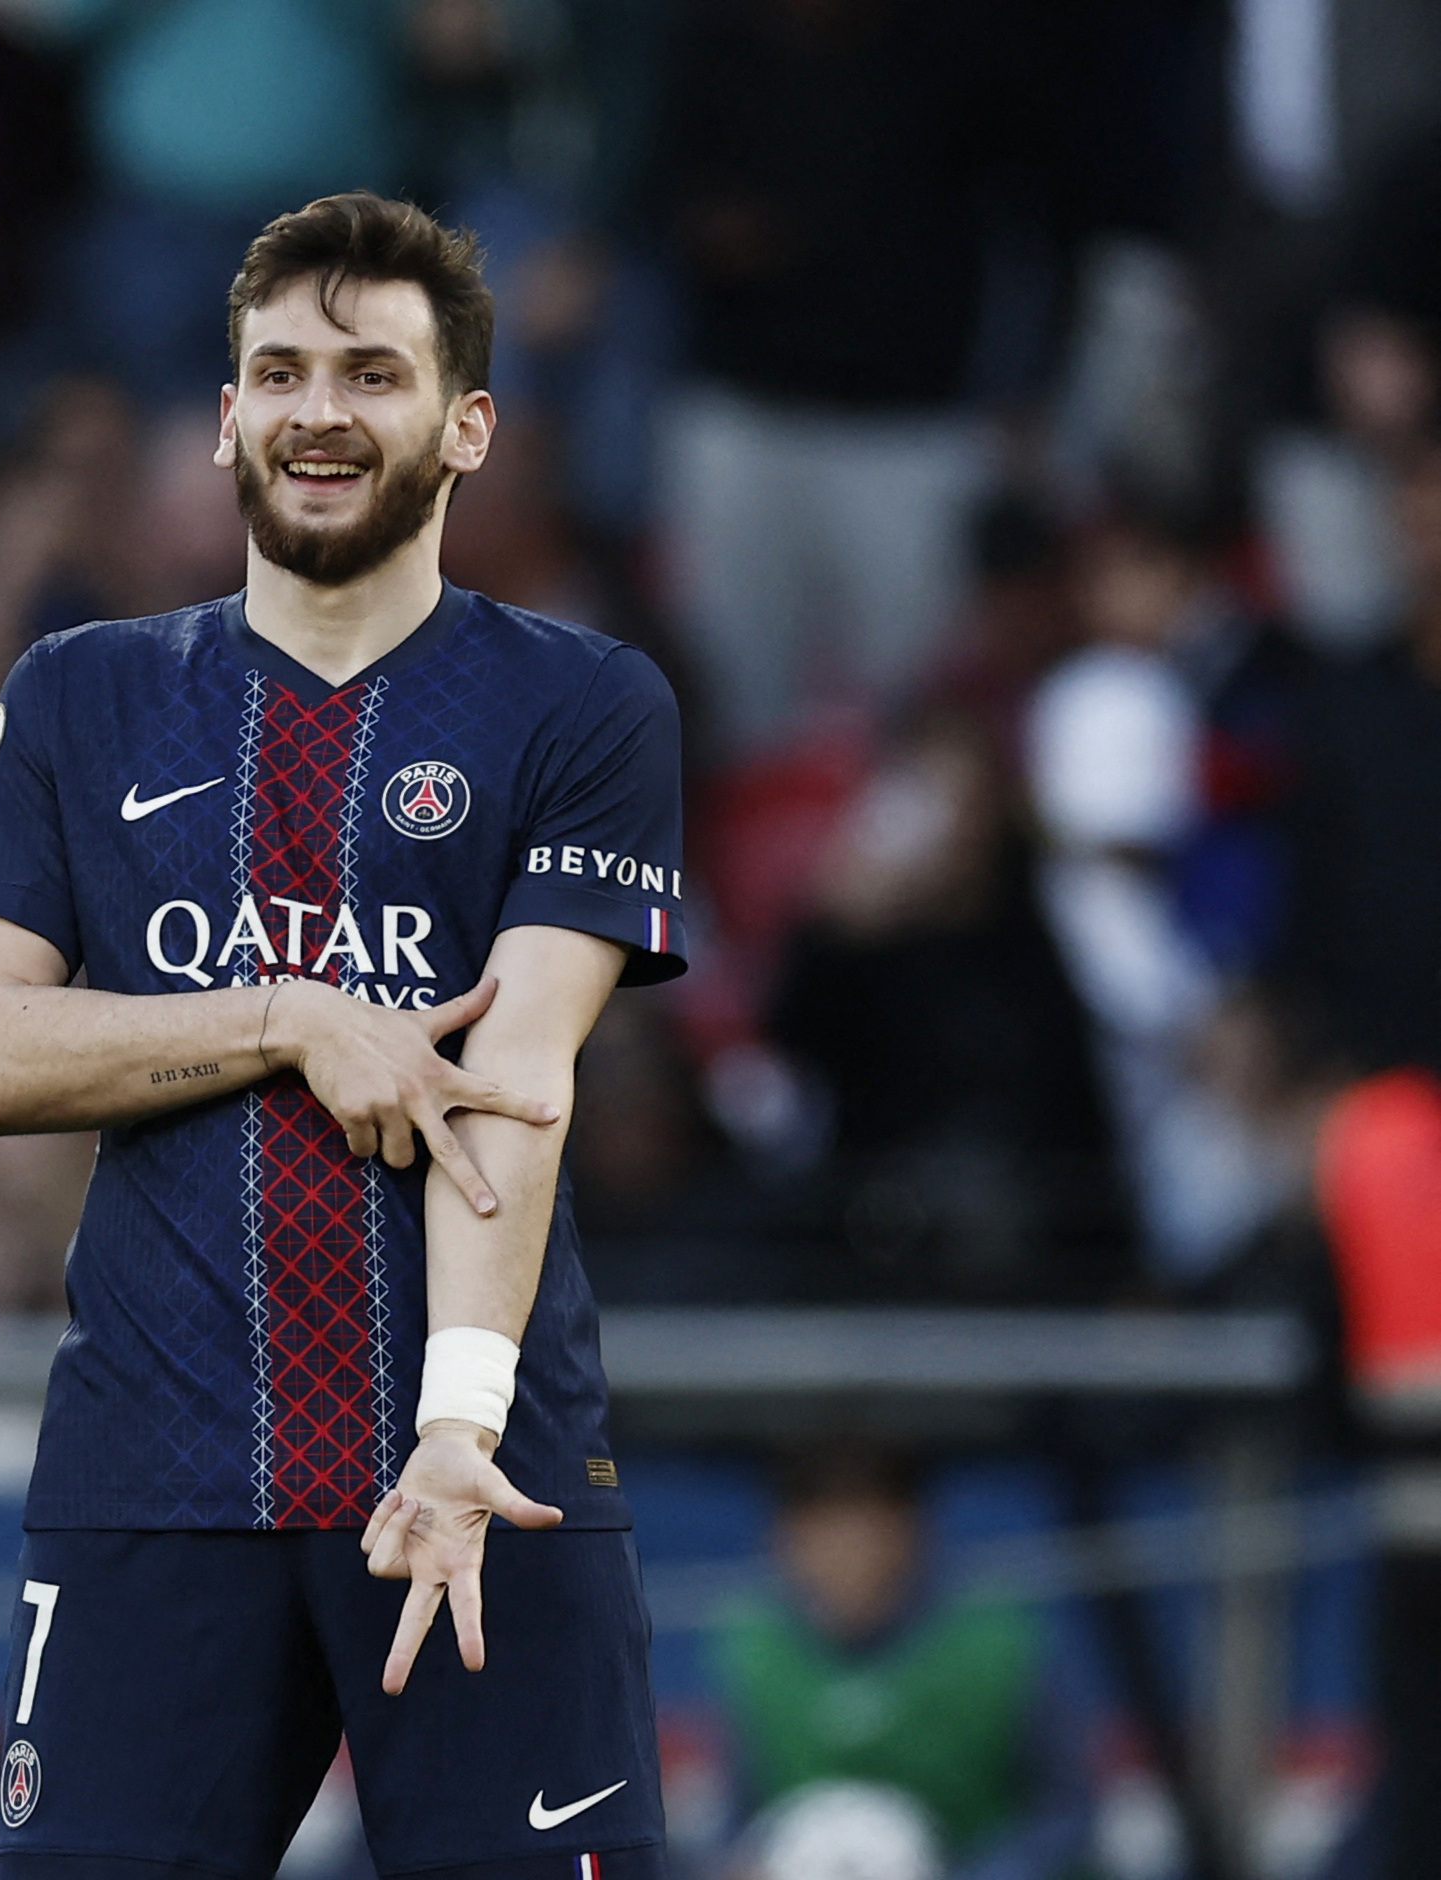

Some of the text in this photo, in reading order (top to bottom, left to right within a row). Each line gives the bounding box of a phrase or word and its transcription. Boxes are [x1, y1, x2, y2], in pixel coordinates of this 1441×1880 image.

[399, 765, 457, 785] PARIS
[146, 894, 437, 988] QATAR
[15, 1579, 60, 1725] 7
[9, 1744, 35, 1767] PARIS
